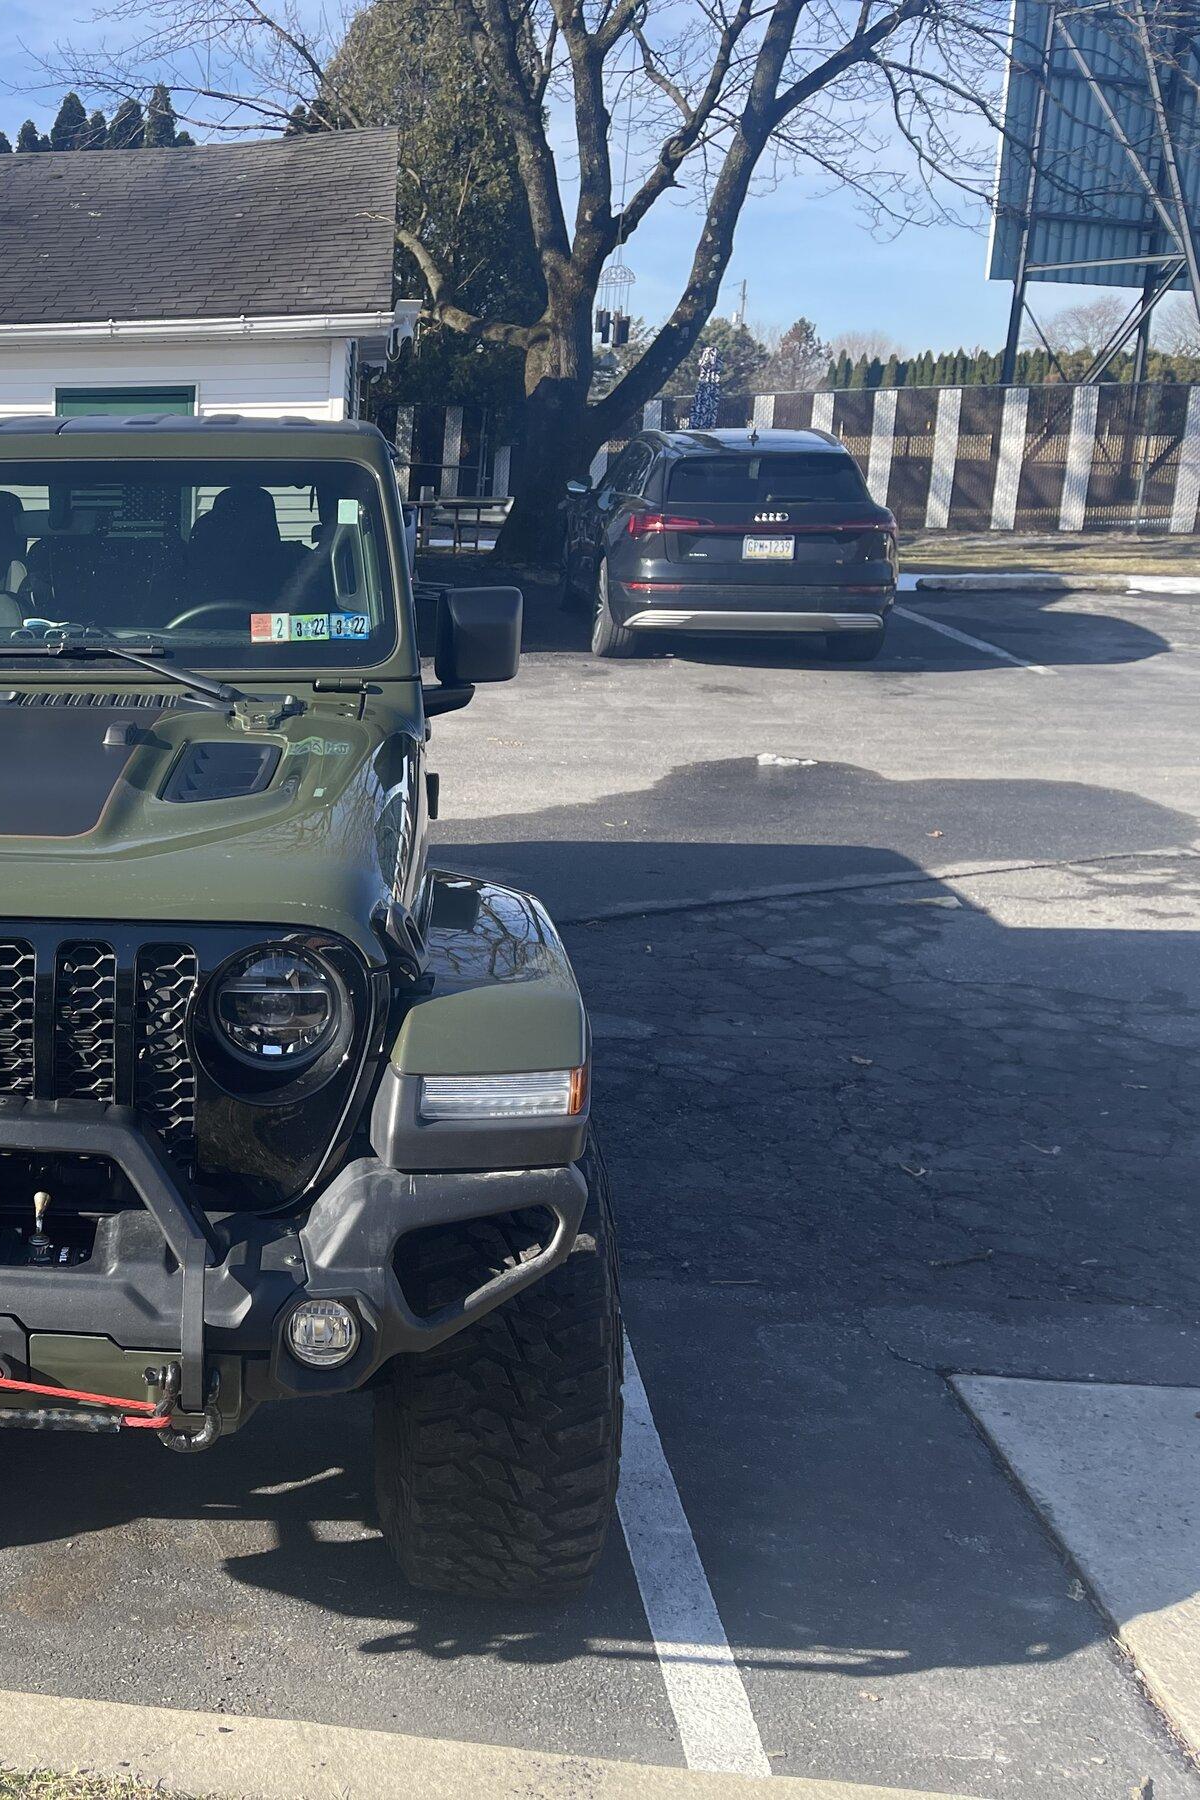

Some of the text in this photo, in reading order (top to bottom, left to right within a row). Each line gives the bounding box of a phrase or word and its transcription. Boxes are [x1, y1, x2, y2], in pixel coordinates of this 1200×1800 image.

[296, 618, 326, 637] 3 22
[335, 617, 365, 635] 3 22
